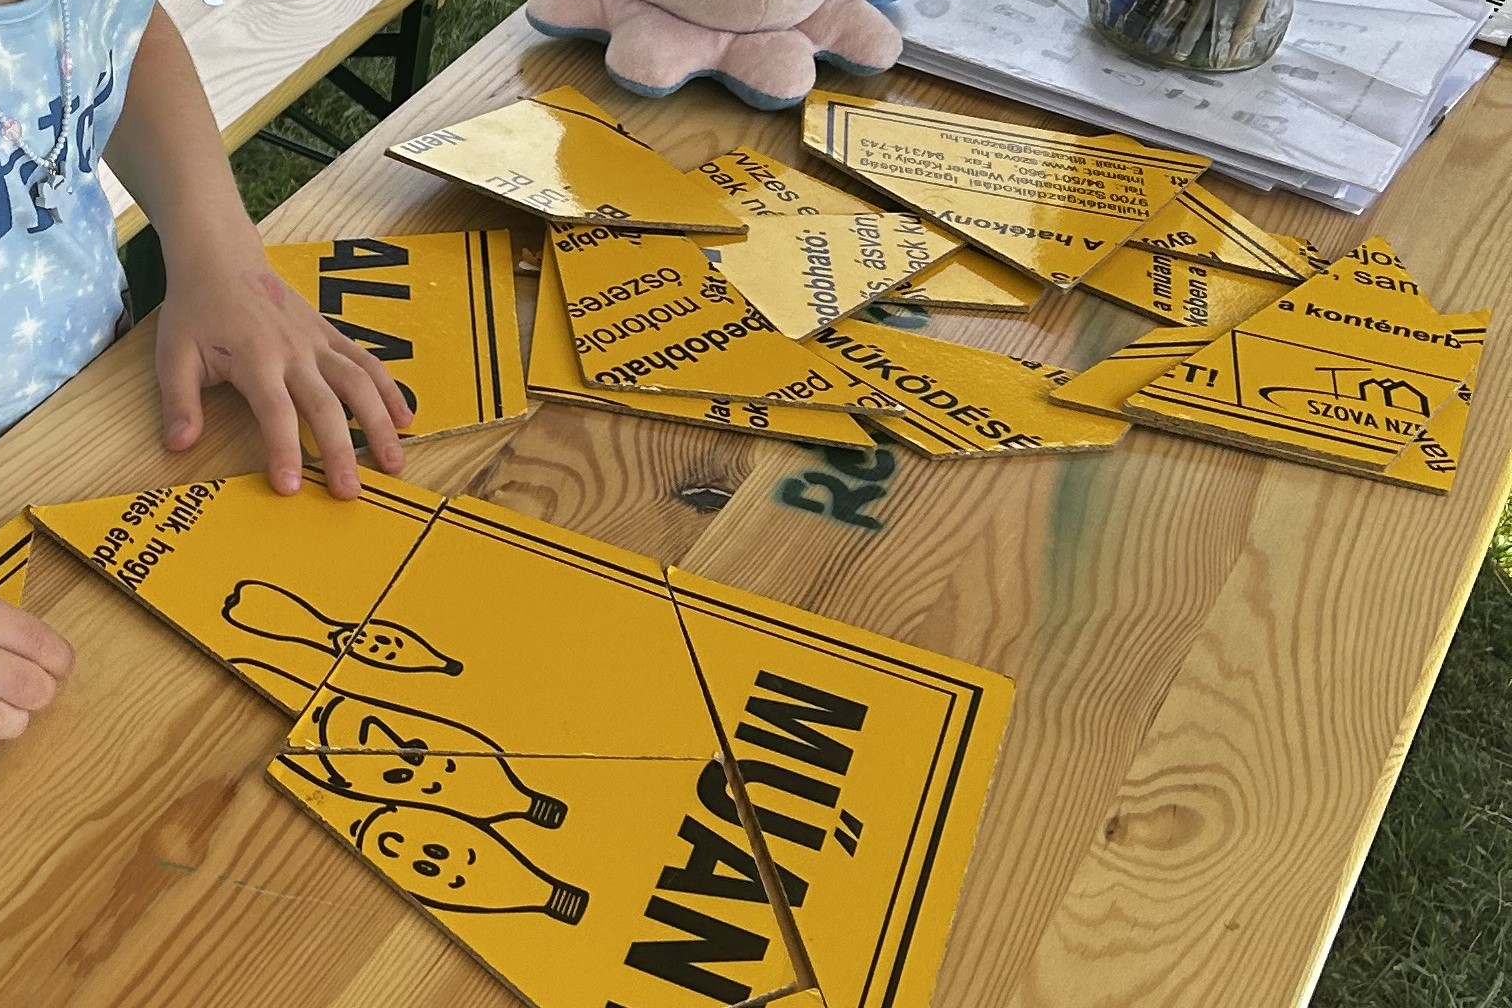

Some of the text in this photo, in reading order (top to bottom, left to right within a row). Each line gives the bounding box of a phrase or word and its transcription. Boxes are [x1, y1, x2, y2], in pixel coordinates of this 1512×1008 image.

[399, 129, 468, 155] Nem
[485, 169, 536, 196] PE
[1084, 237, 1106, 252] A
[1278, 299, 1296, 313] a
[1306, 399, 1380, 430] SZOVA
[116, 536, 176, 592] hogy
[605, 669, 869, 1008] MŰAN
